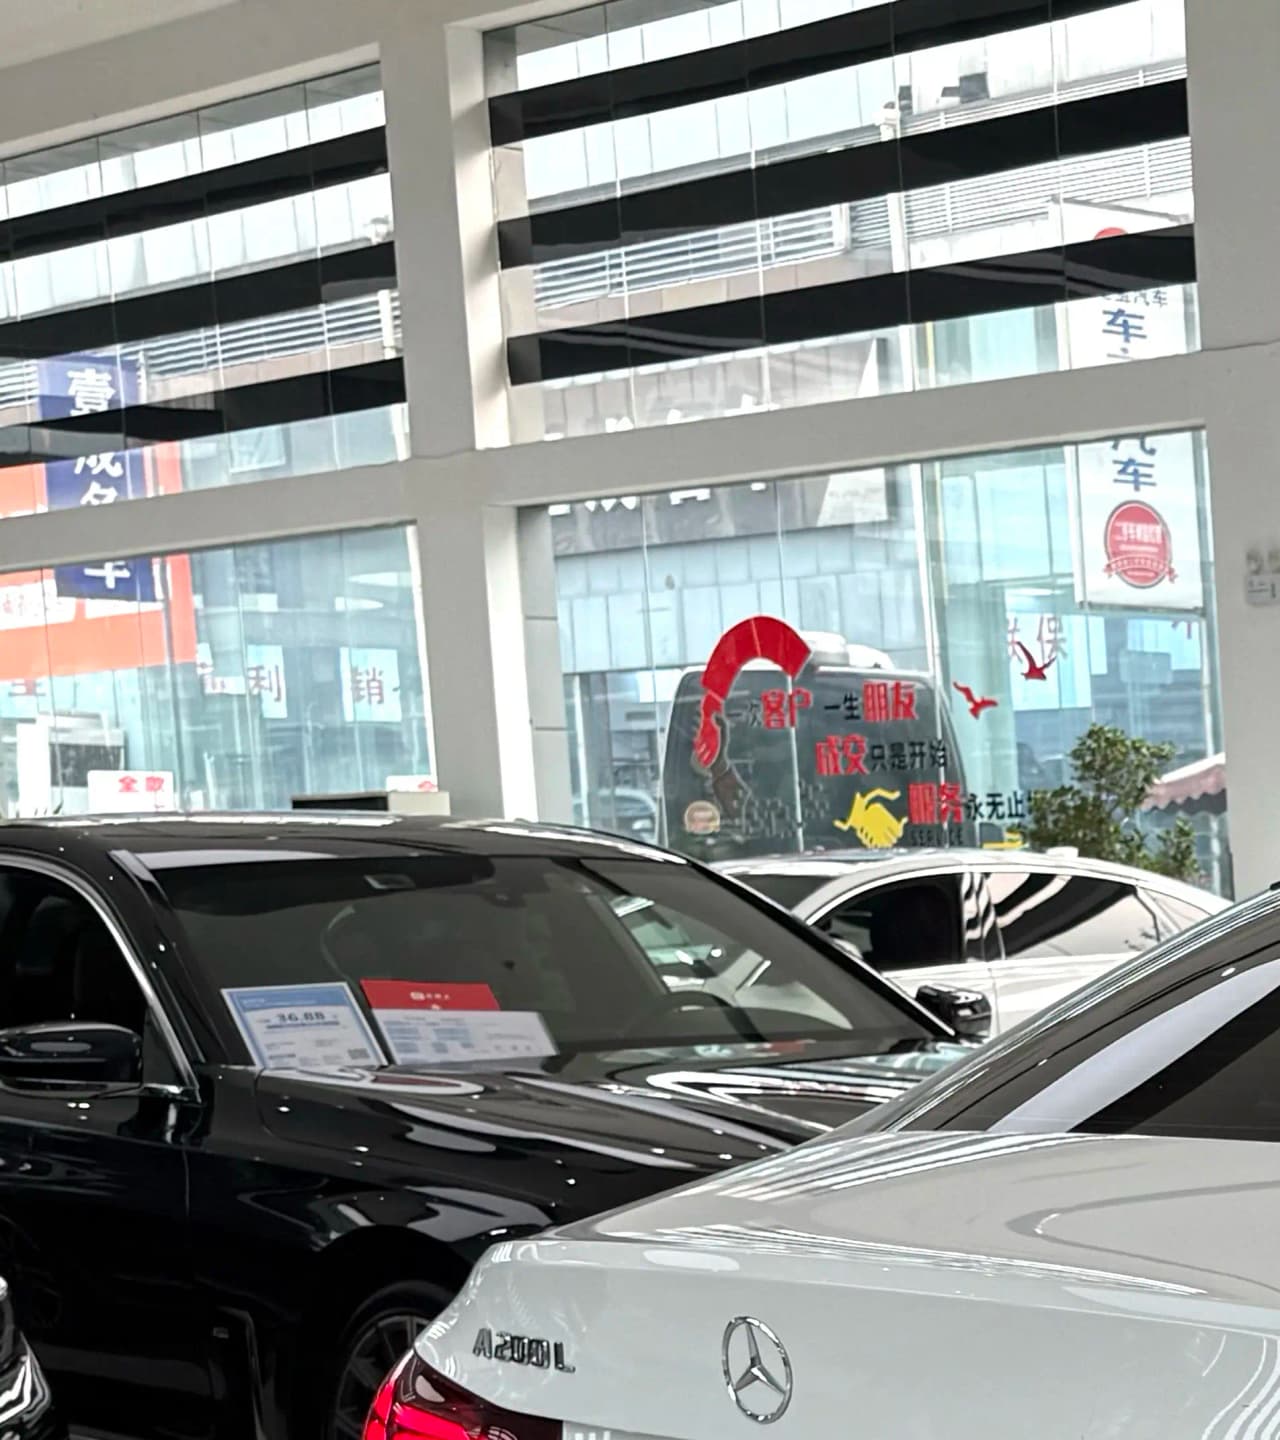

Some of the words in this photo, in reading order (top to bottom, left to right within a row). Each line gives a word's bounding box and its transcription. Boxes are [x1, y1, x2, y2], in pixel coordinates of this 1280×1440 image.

[824, 680, 918, 723] 一生朋友
[815, 733, 948, 776] 成交只是开始
[908, 782, 1034, 825] 服务永无止
